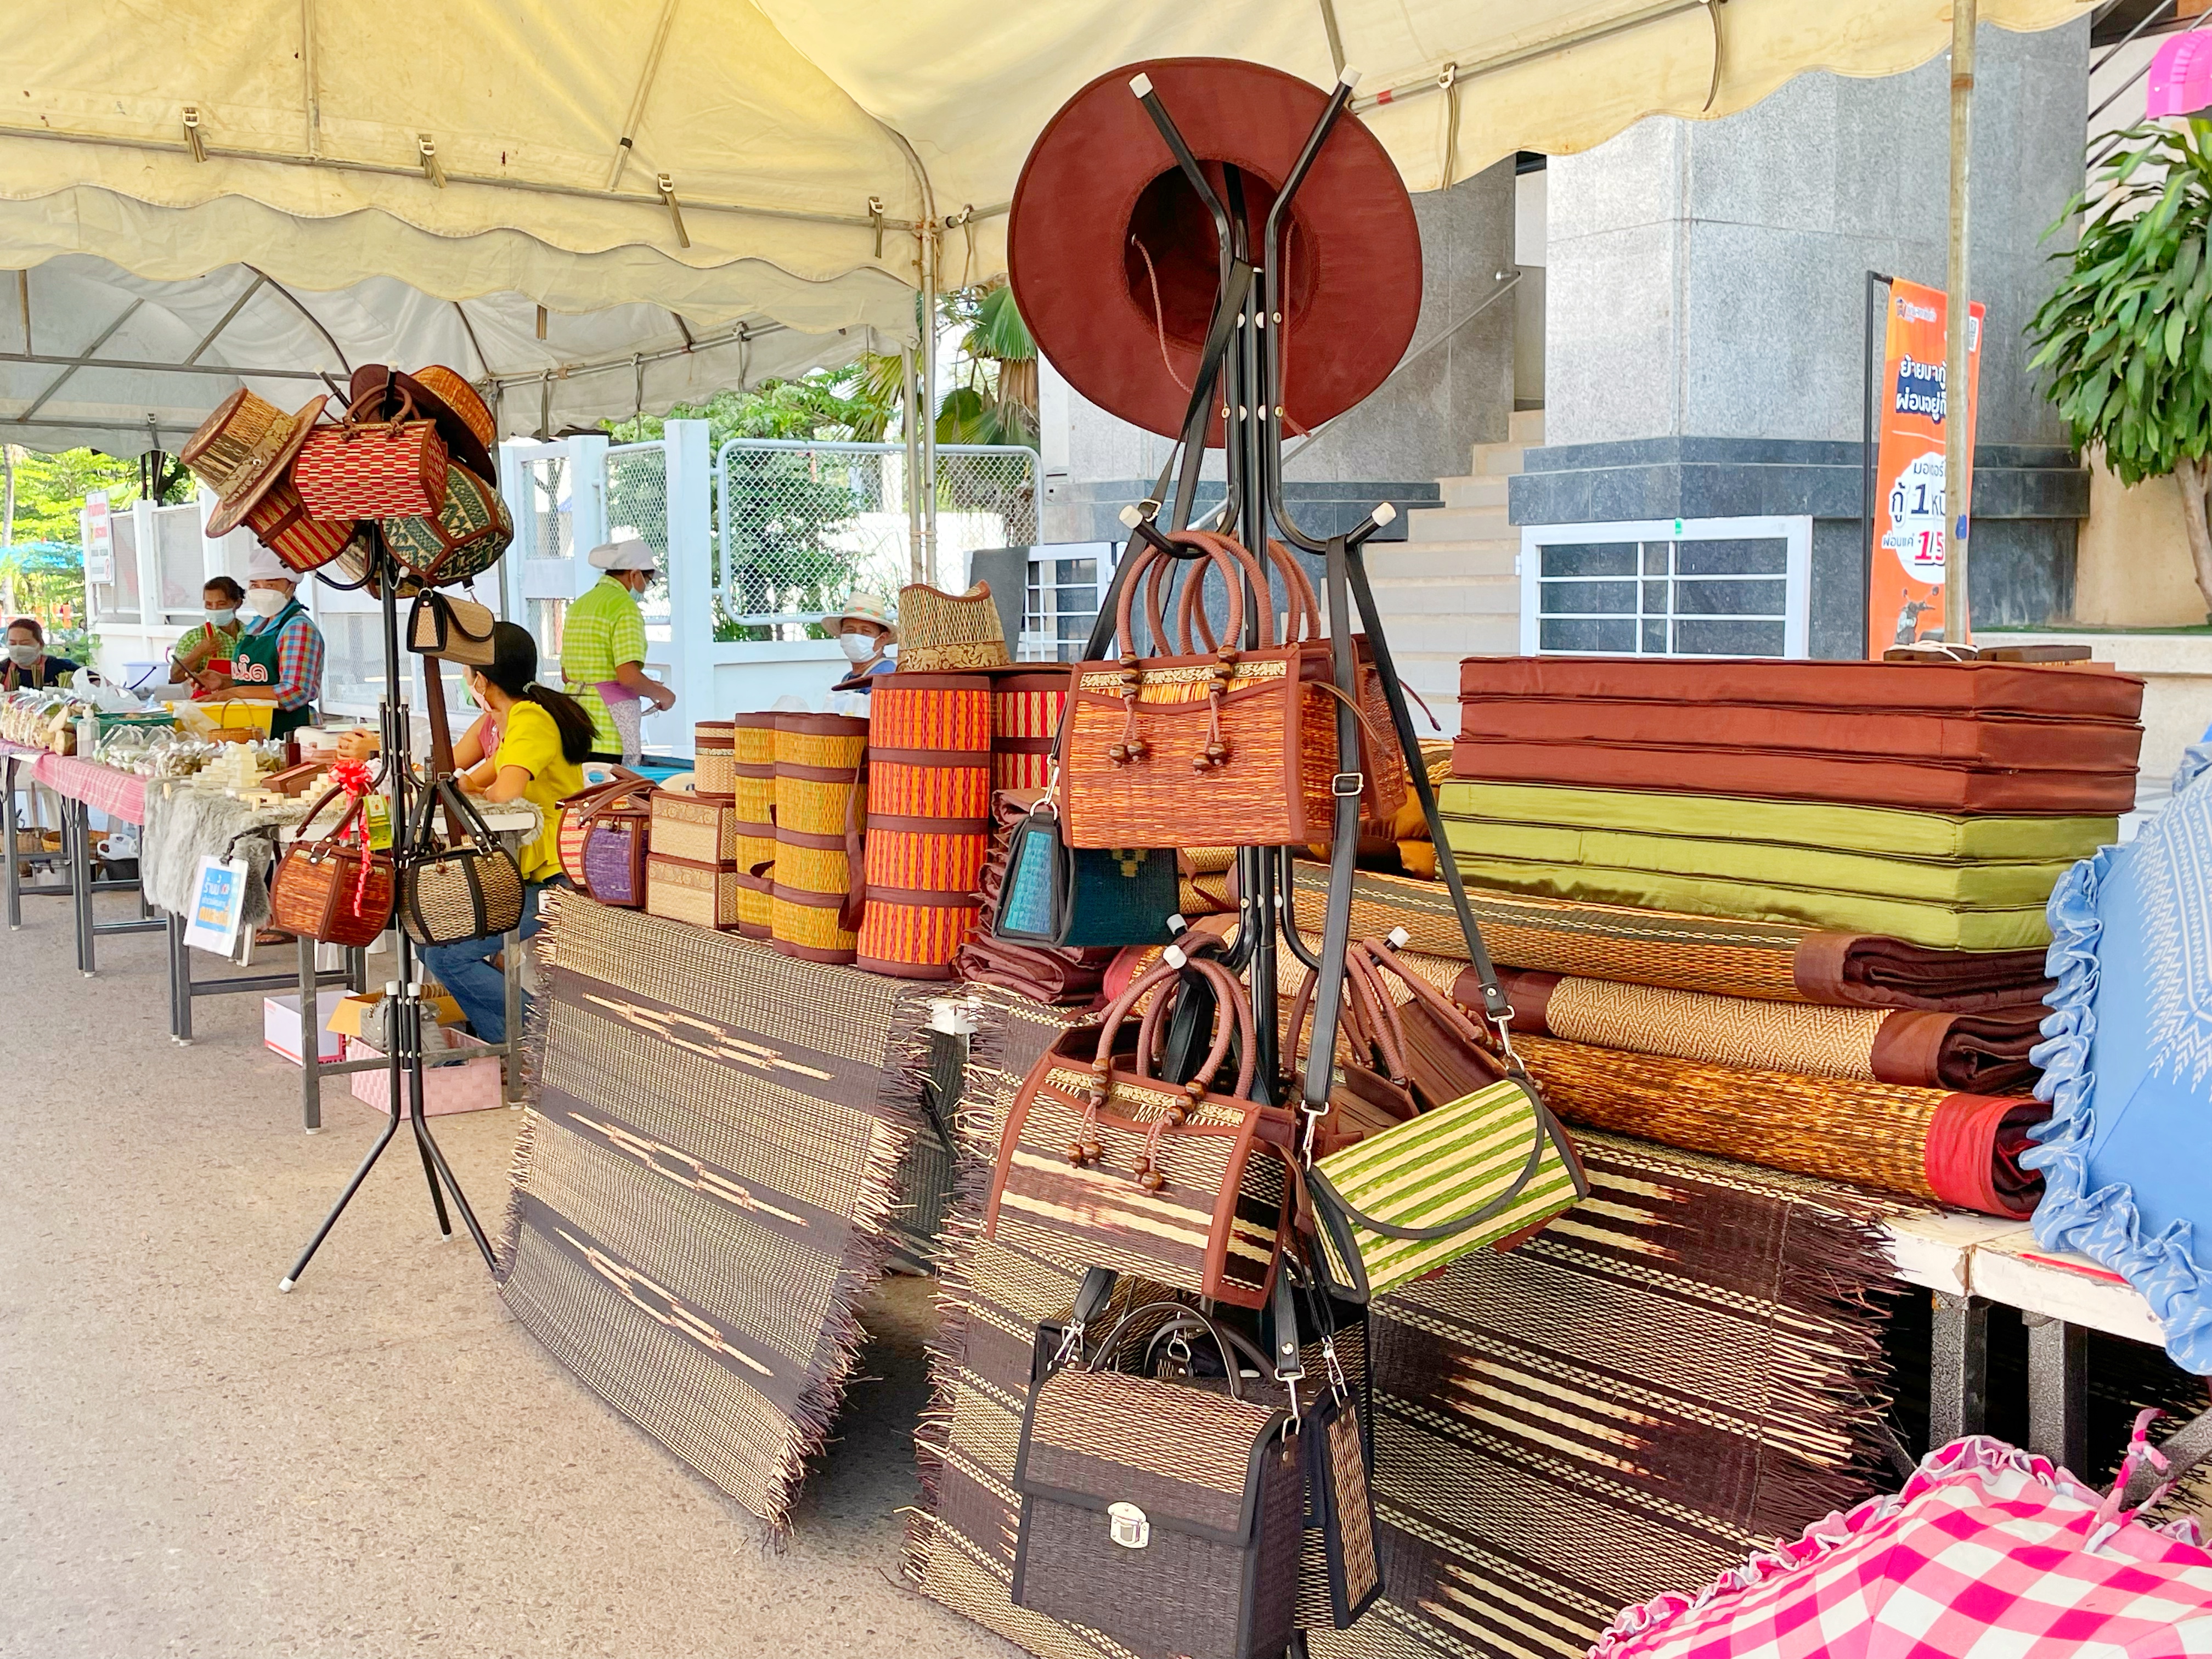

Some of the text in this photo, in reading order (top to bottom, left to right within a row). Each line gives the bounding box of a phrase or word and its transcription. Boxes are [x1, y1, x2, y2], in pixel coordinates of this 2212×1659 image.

[1892, 482, 1905, 522] กู้
[1911, 483, 1929, 515] 1
[1883, 533, 1915, 547] ผ่อนแค่
